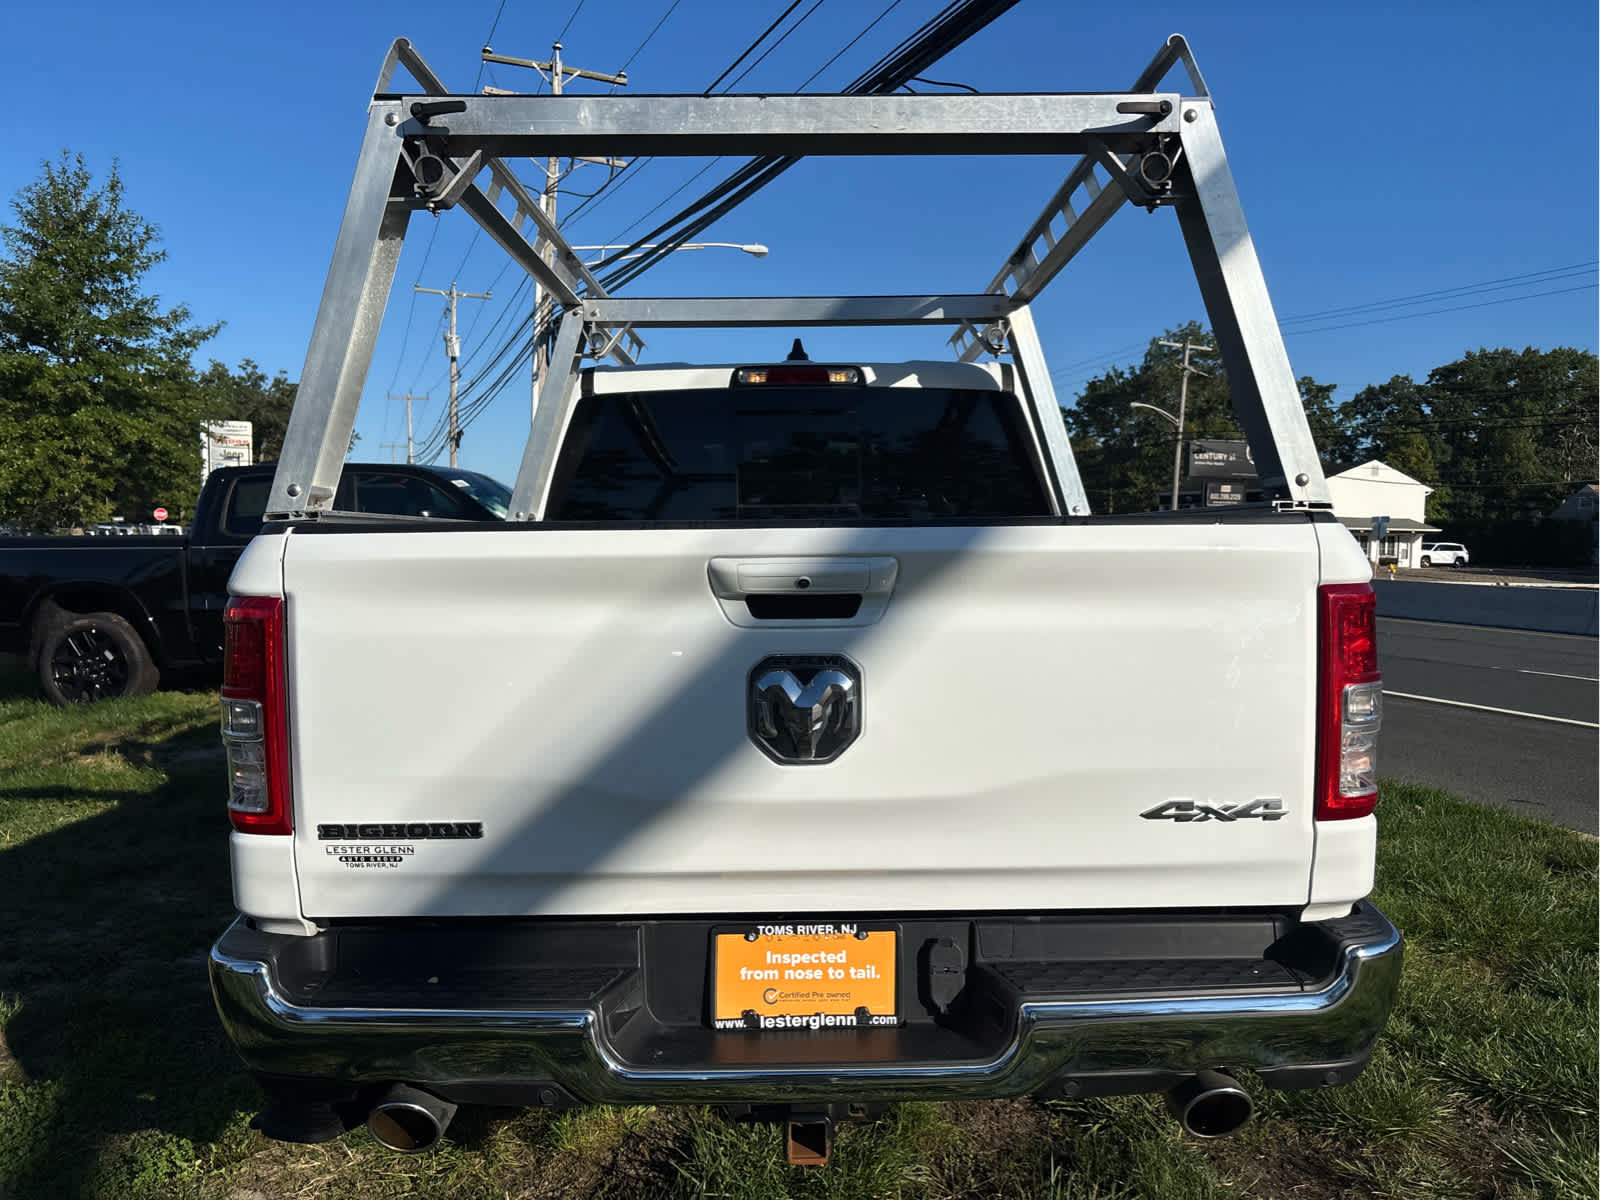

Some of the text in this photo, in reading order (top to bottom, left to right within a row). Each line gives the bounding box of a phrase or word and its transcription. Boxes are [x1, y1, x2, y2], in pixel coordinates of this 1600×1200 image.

[325, 846, 415, 854] LESTER GLENN
[757, 925, 794, 936] TOMS
[841, 924, 858, 934] NJ
[766, 950, 847, 966] Inspected
[740, 965, 881, 981] from nose to tail.
[779, 991, 810, 999] Certified
[715, 1013, 898, 1030] www. lesterglenn .com
